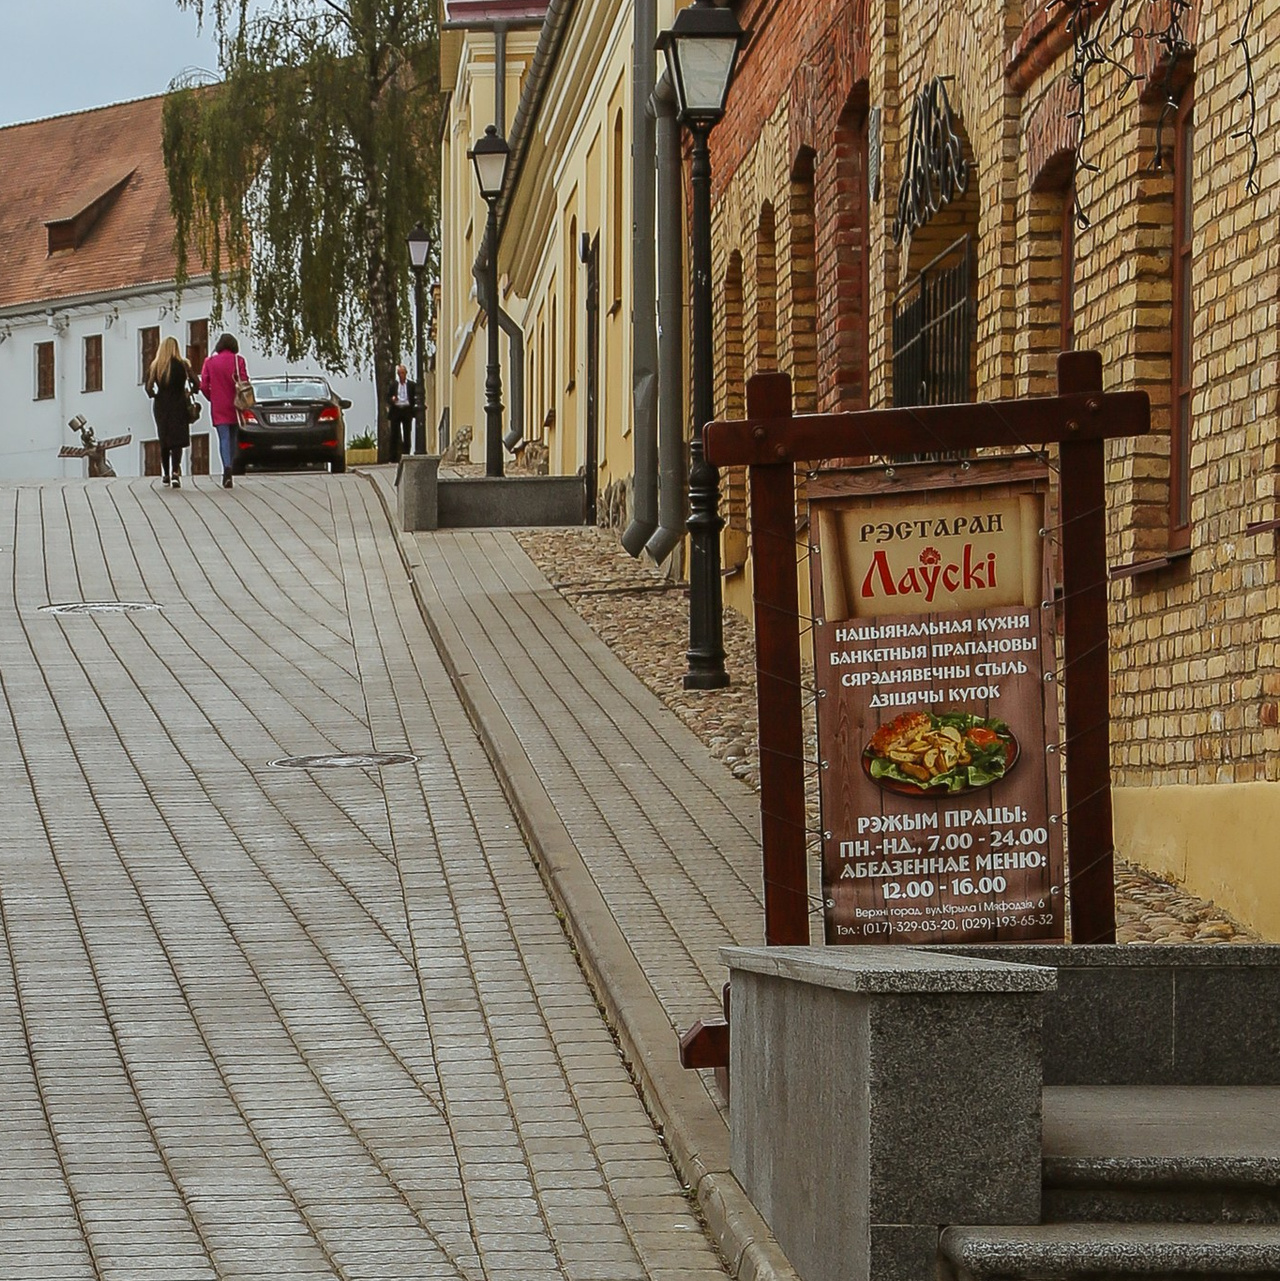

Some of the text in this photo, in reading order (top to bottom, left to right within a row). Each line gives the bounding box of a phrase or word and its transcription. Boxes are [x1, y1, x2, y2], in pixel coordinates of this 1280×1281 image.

[859, 514, 1004, 543] РЭСТАРАН
[861, 544, 997, 602] Лаўскі
[835, 615, 1030, 642] НАЦЫЯНАЛЬНАЯ КУХНЯ
[830, 637, 1037, 666] БАНКЕТНЫЯ ПРАПАНОВЫ
[841, 661, 1028, 686] СЯРЭДНЯВЕЧНЫ СТЫЛЬ
[869, 685, 1000, 708] ДЗІЦЯЧЫ КУТОК
[857, 806, 1027, 834] РЭЖЫМ ПРАЦЫ:
[927, 832, 973, 852] 7.00
[990, 827, 1048, 847] 24.00
[840, 850, 1047, 879] АБЕДЗЕННАЕ МЕНЮ:
[882, 880, 935, 900] 12.00
[951, 875, 1007, 896] 16.00
[855, 907, 889, 919] Верхні
[1037, 898, 1045, 909] 6
[961, 914, 1054, 931] (029)-193-65-32
